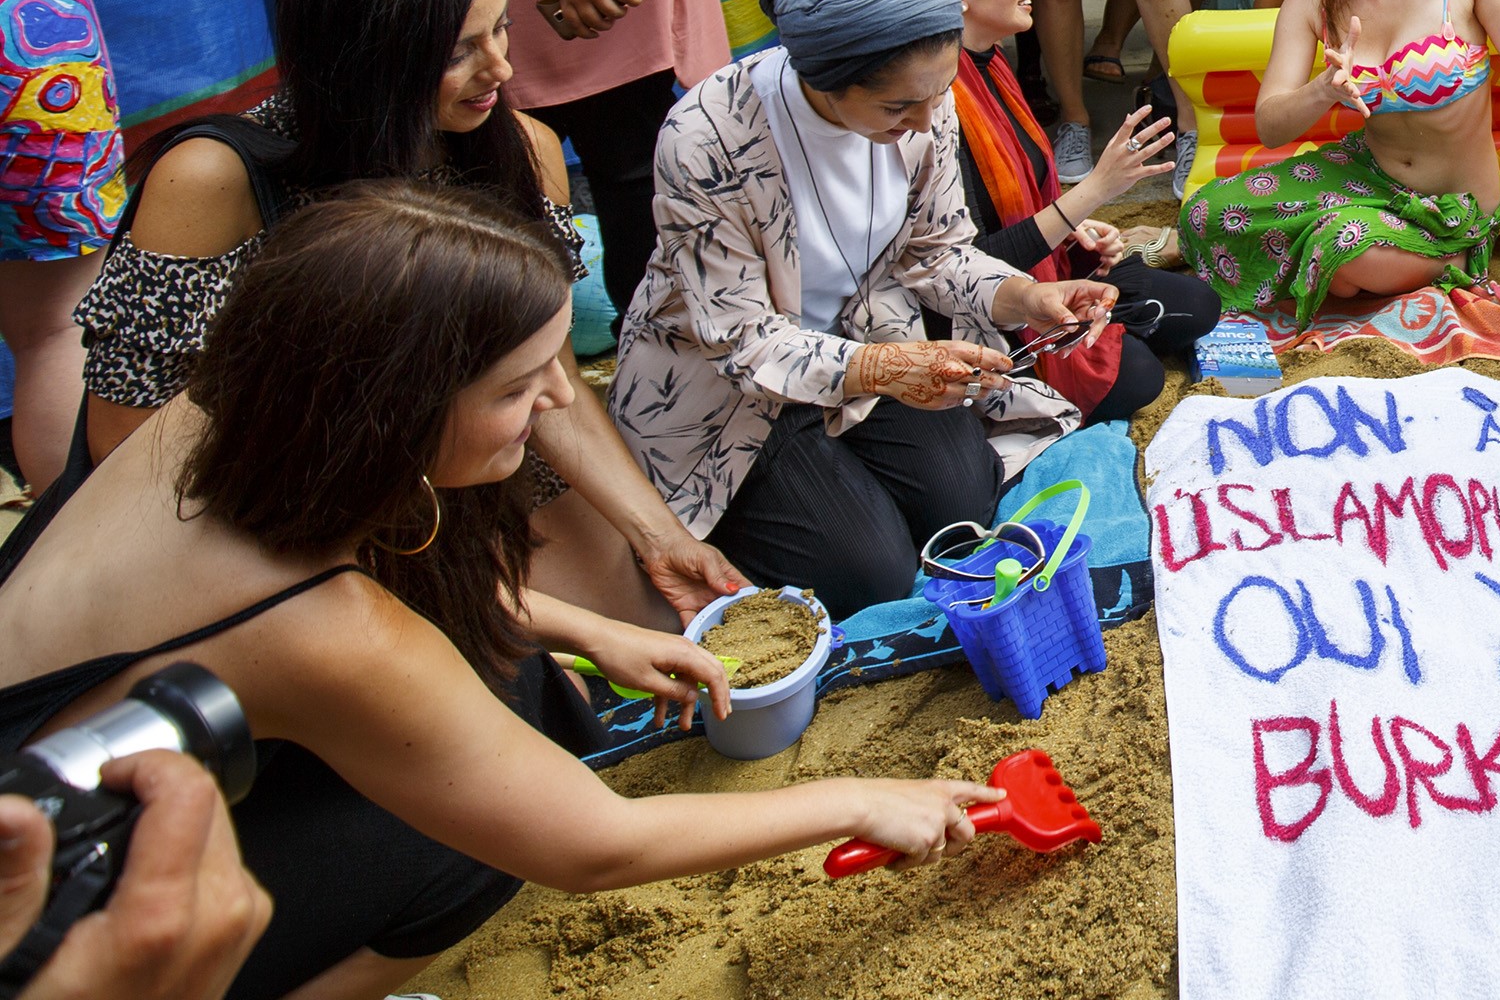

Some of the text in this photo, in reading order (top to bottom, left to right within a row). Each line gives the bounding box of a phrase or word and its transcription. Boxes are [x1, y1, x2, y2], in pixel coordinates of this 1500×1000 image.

[1209, 331, 1256, 339] rance
[1206, 384, 1406, 476] NON
[1214, 575, 1423, 684] OUI
